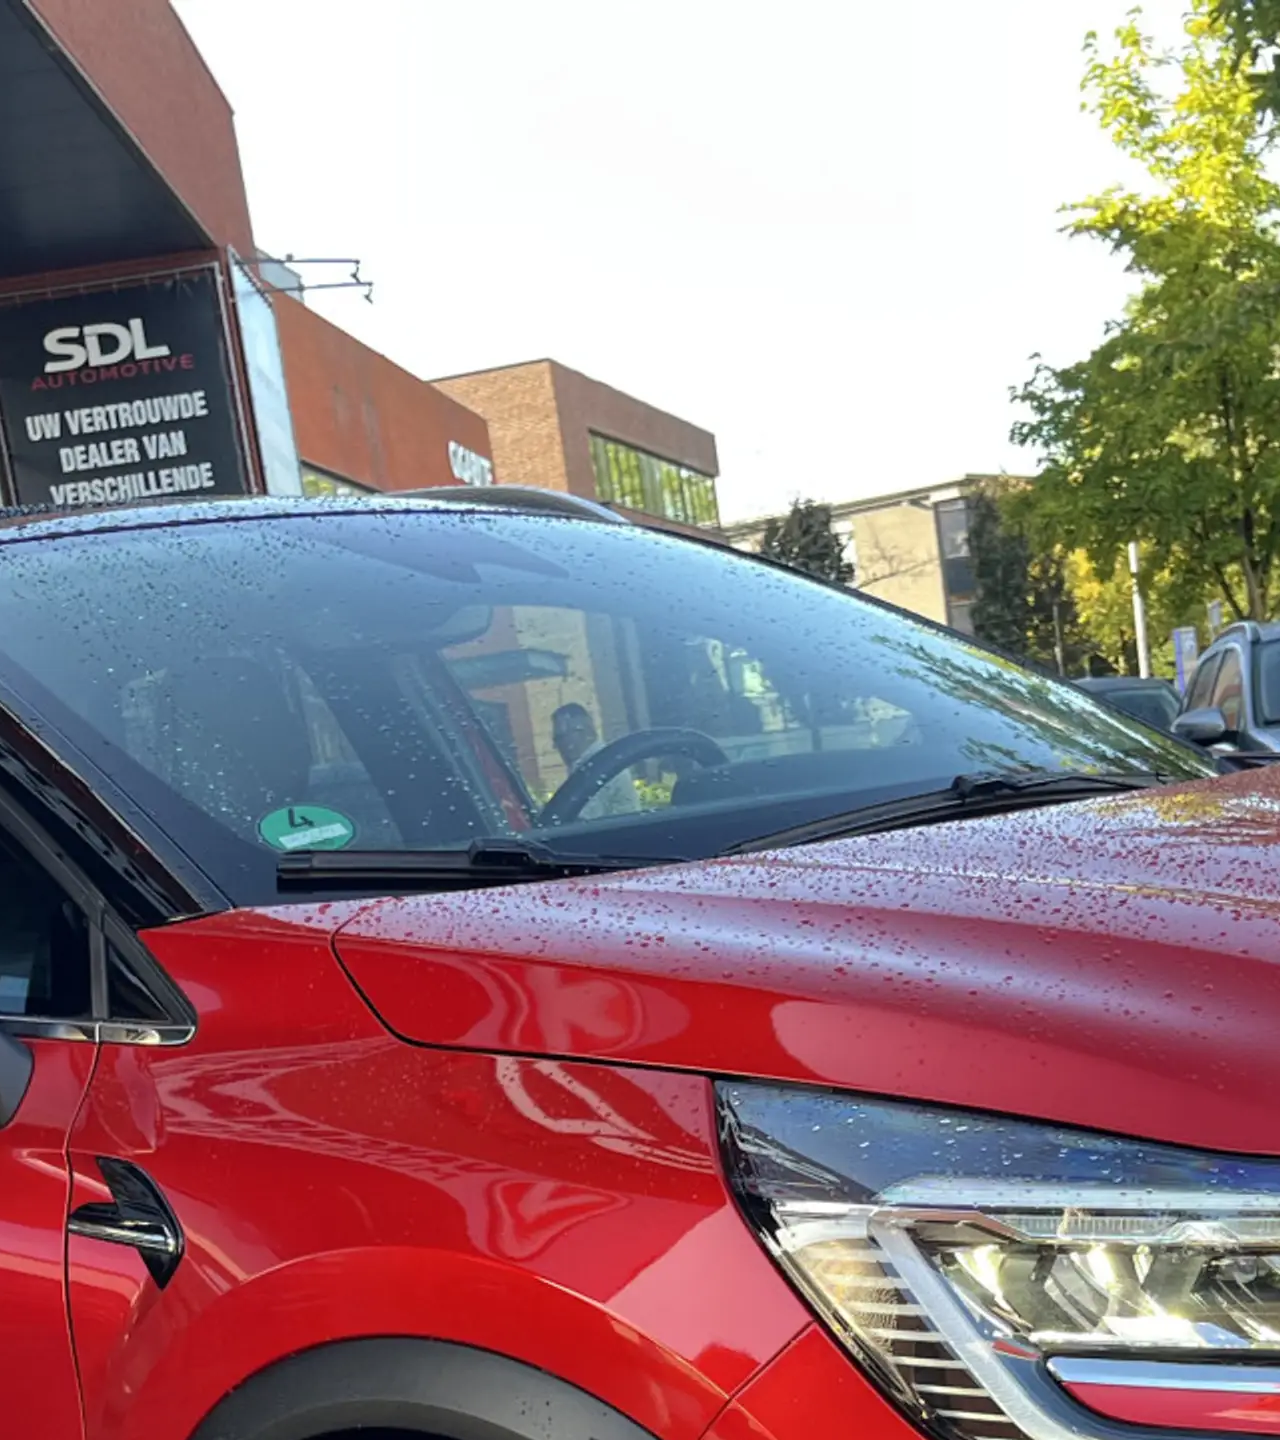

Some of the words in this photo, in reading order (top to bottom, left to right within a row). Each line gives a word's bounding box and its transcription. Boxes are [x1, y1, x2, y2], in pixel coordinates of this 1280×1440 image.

[42, 317, 171, 374] SDL
[31, 353, 195, 391] AUTOMOTIVE
[25, 413, 61, 442] UW
[64, 390, 209, 436] VERTROUWDE
[59, 438, 141, 473] DEALER
[142, 430, 188, 460] VAN
[49, 462, 216, 505] VERSCHILLENDE
